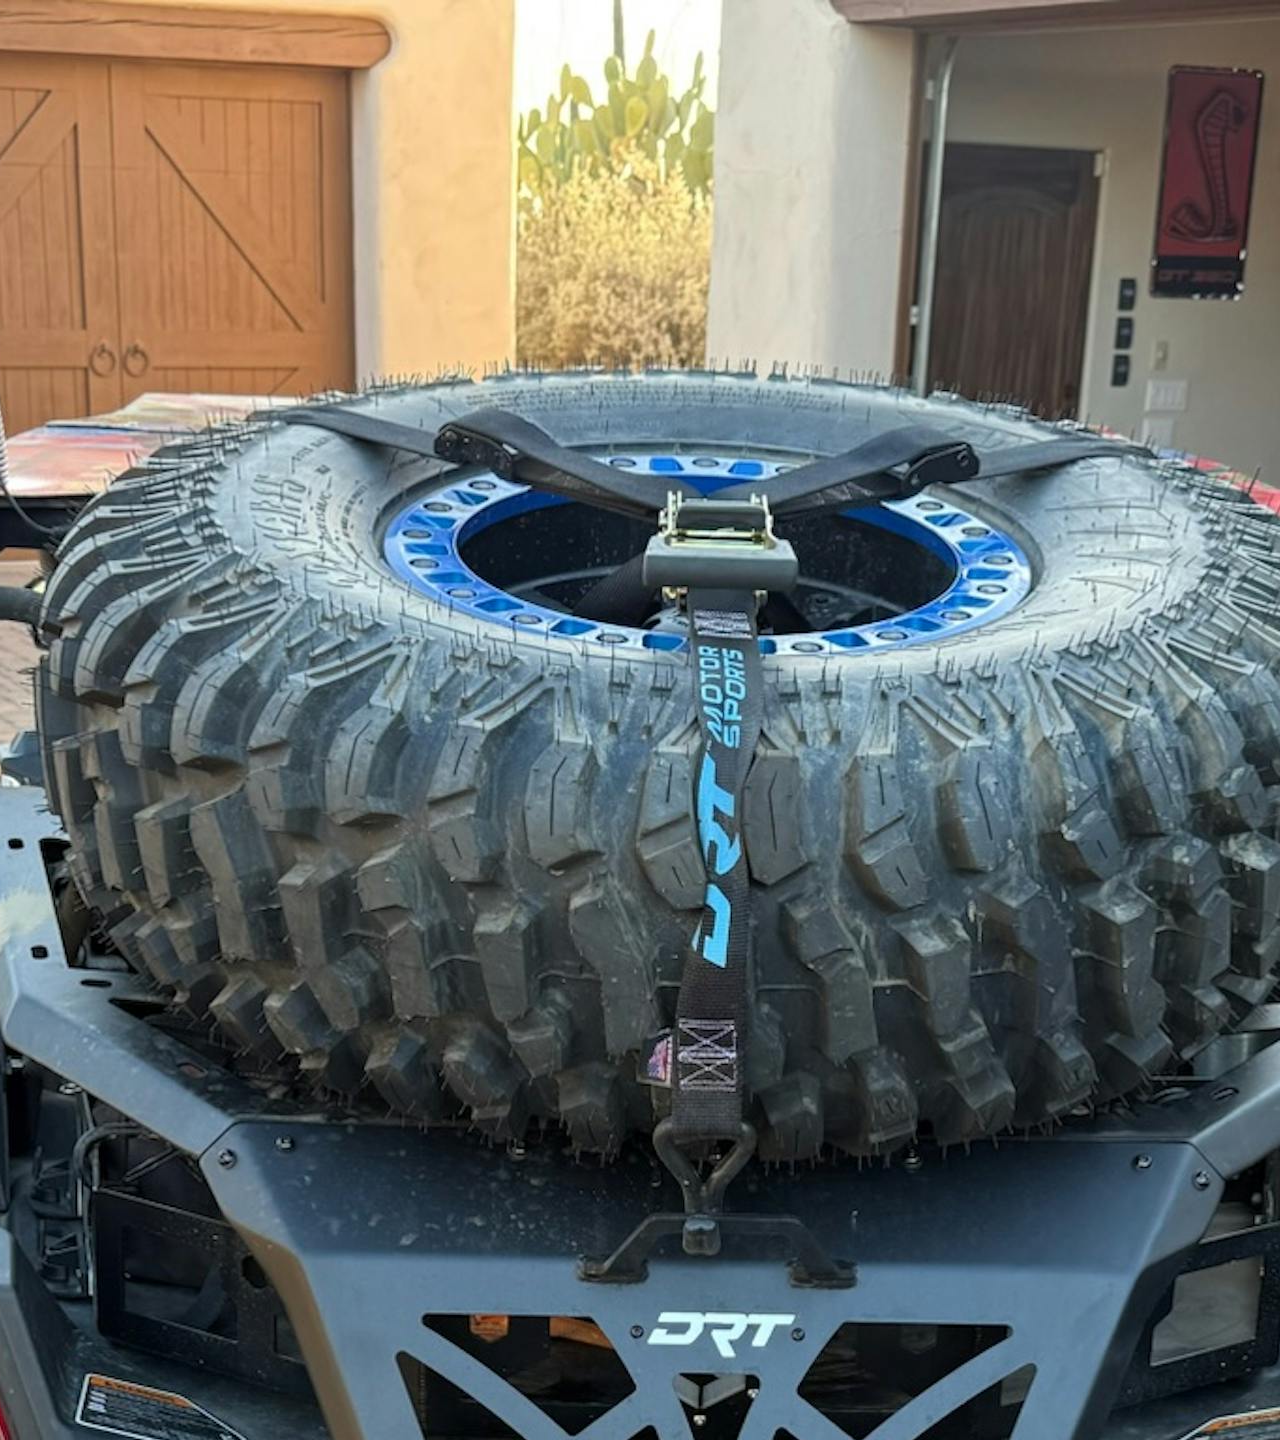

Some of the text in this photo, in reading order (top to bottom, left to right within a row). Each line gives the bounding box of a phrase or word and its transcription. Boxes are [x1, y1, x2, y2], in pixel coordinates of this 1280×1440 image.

[699, 645, 724, 743] MOTOR
[722, 648, 746, 749] SPORTS
[647, 1311, 796, 1358] DRT
